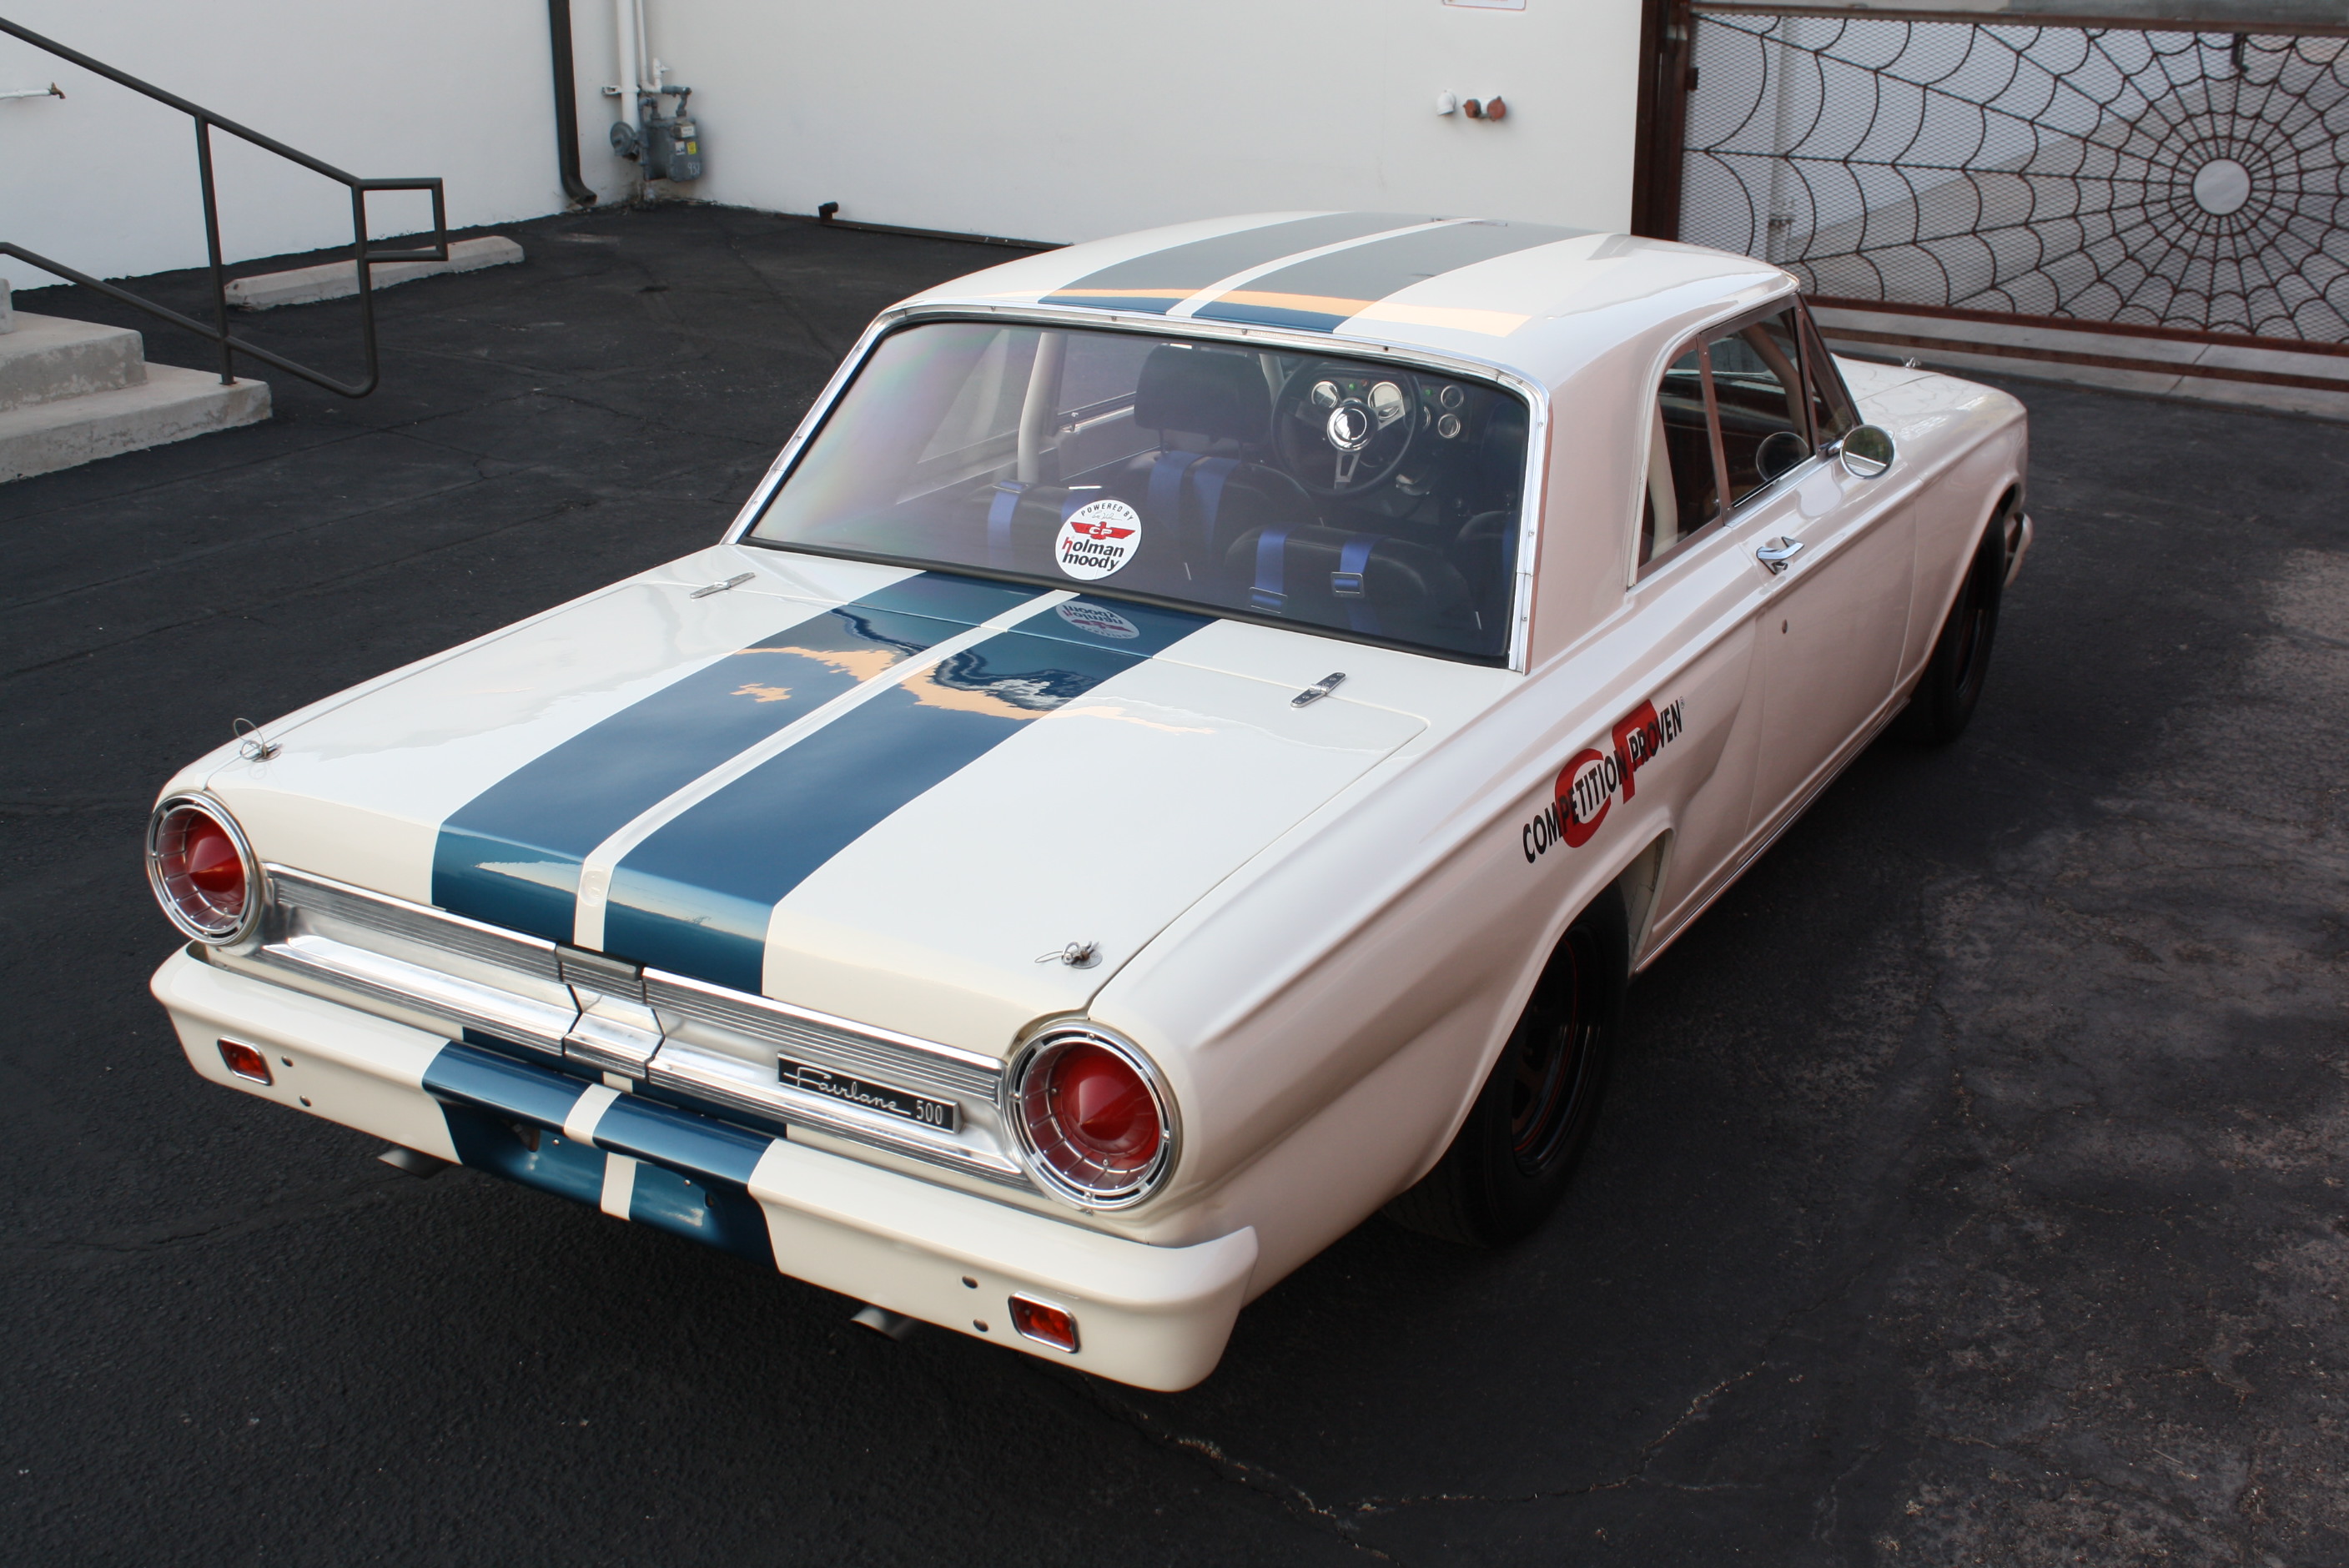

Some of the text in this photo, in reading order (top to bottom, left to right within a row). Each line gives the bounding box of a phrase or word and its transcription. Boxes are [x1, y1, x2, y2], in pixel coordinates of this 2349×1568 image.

[1081, 503, 1123, 516] POWERED
[1124, 510, 1134, 520] BY
[1062, 536, 1124, 557] holman
[1062, 552, 1119, 571] moody
[1522, 699, 1683, 864] COMPETITION PROVEN
[783, 1067, 943, 1125] Fairlane 500
